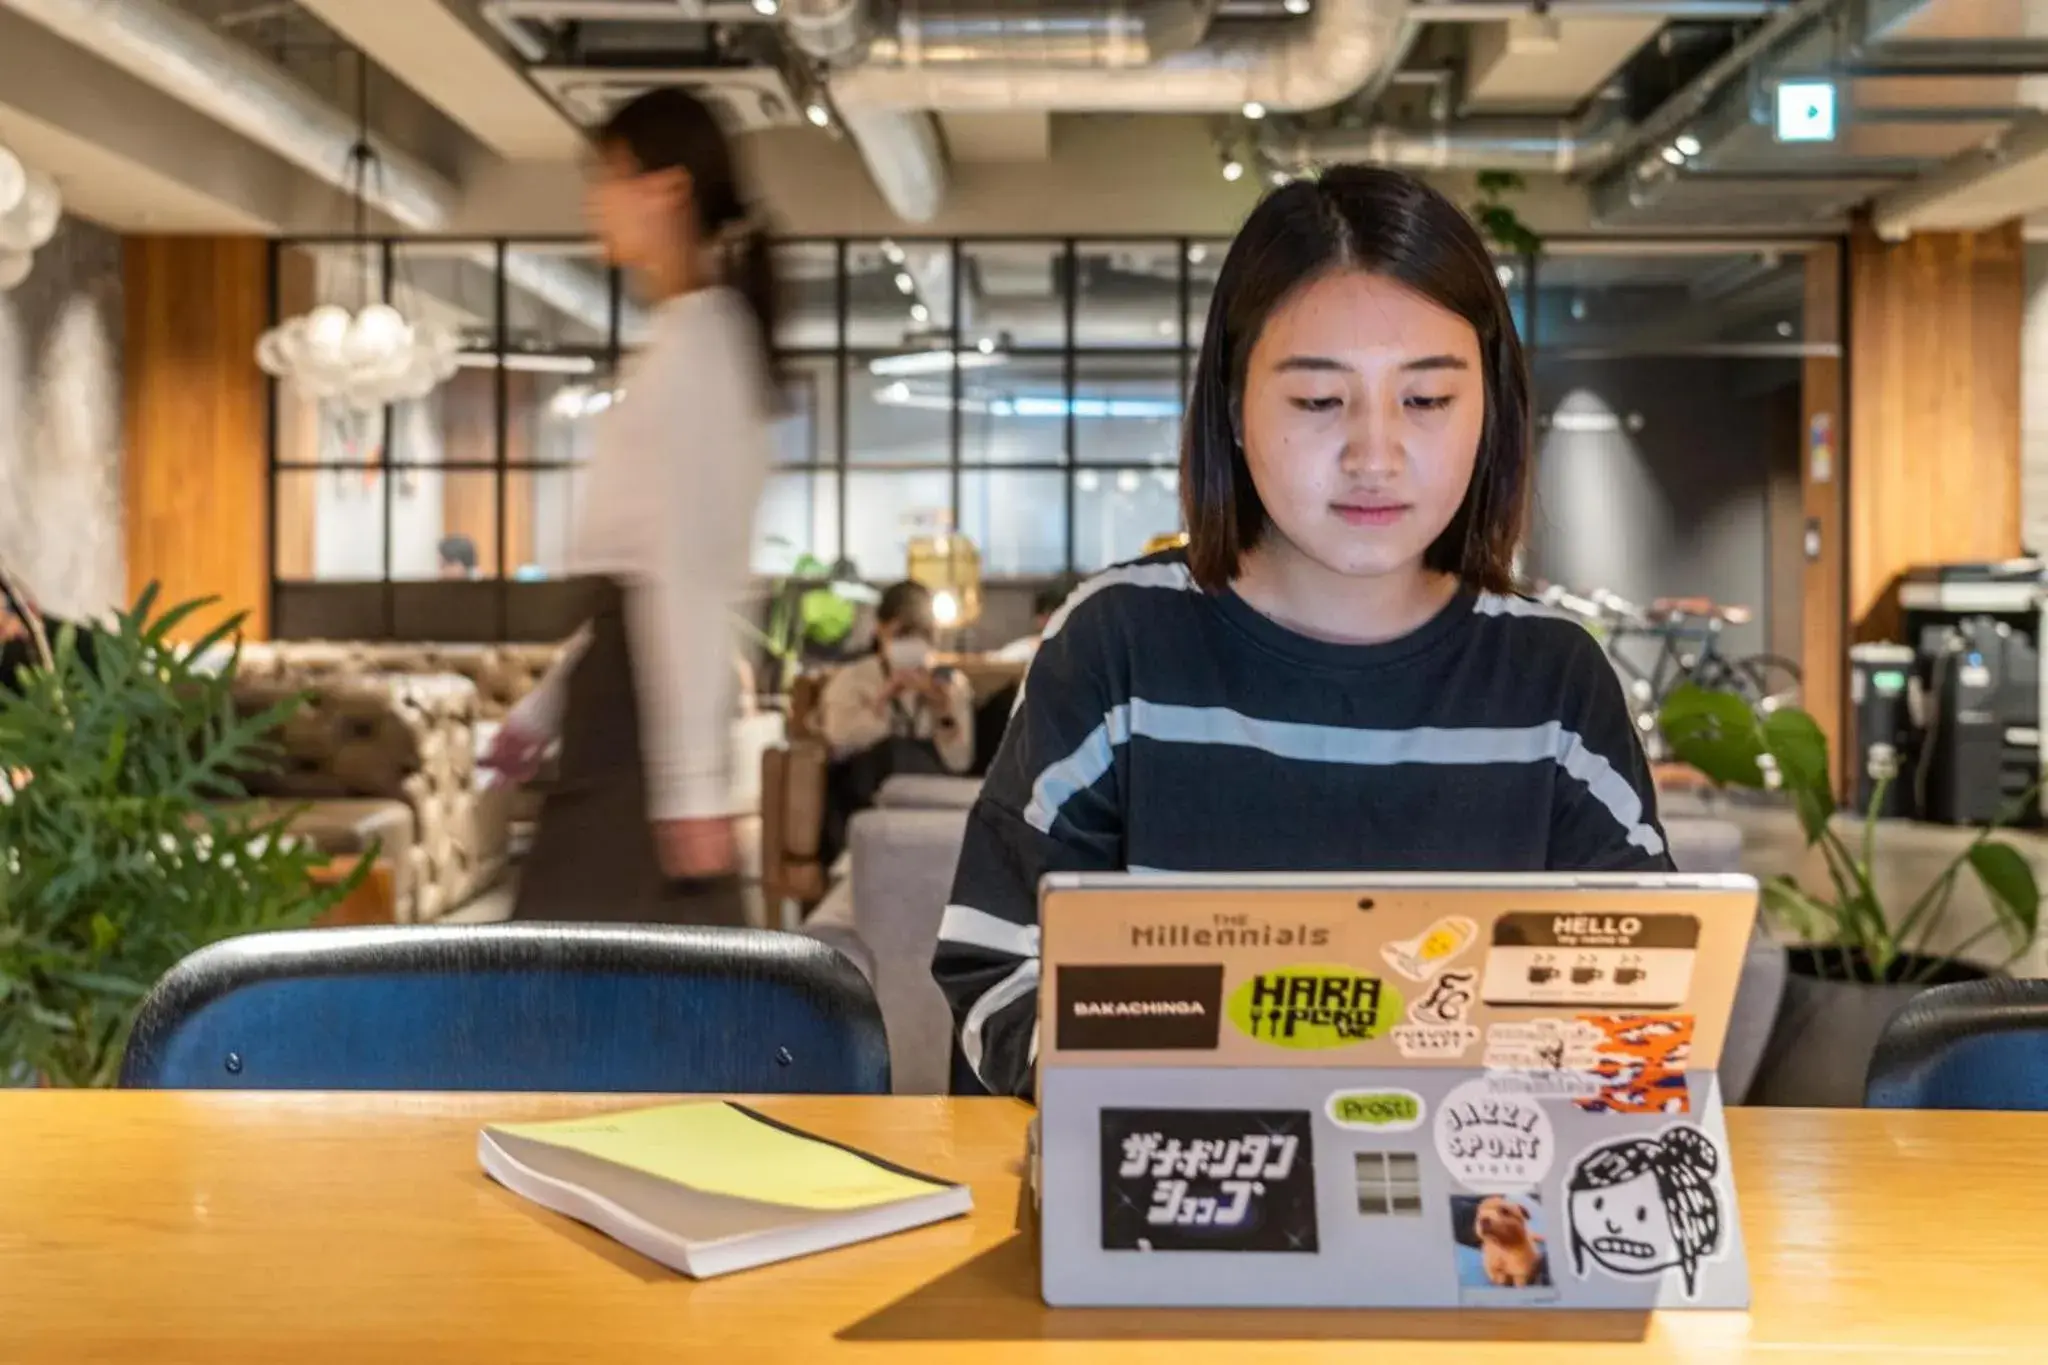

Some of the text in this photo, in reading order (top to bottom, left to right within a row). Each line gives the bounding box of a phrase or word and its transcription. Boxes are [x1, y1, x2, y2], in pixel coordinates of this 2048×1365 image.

[1213, 913, 1249, 926] THE
[1552, 916, 1642, 936] HELLO
[1130, 924, 1331, 948] Millennials
[1252, 975, 1382, 1008] HARA
[1449, 1135, 1541, 1159] SPORT
